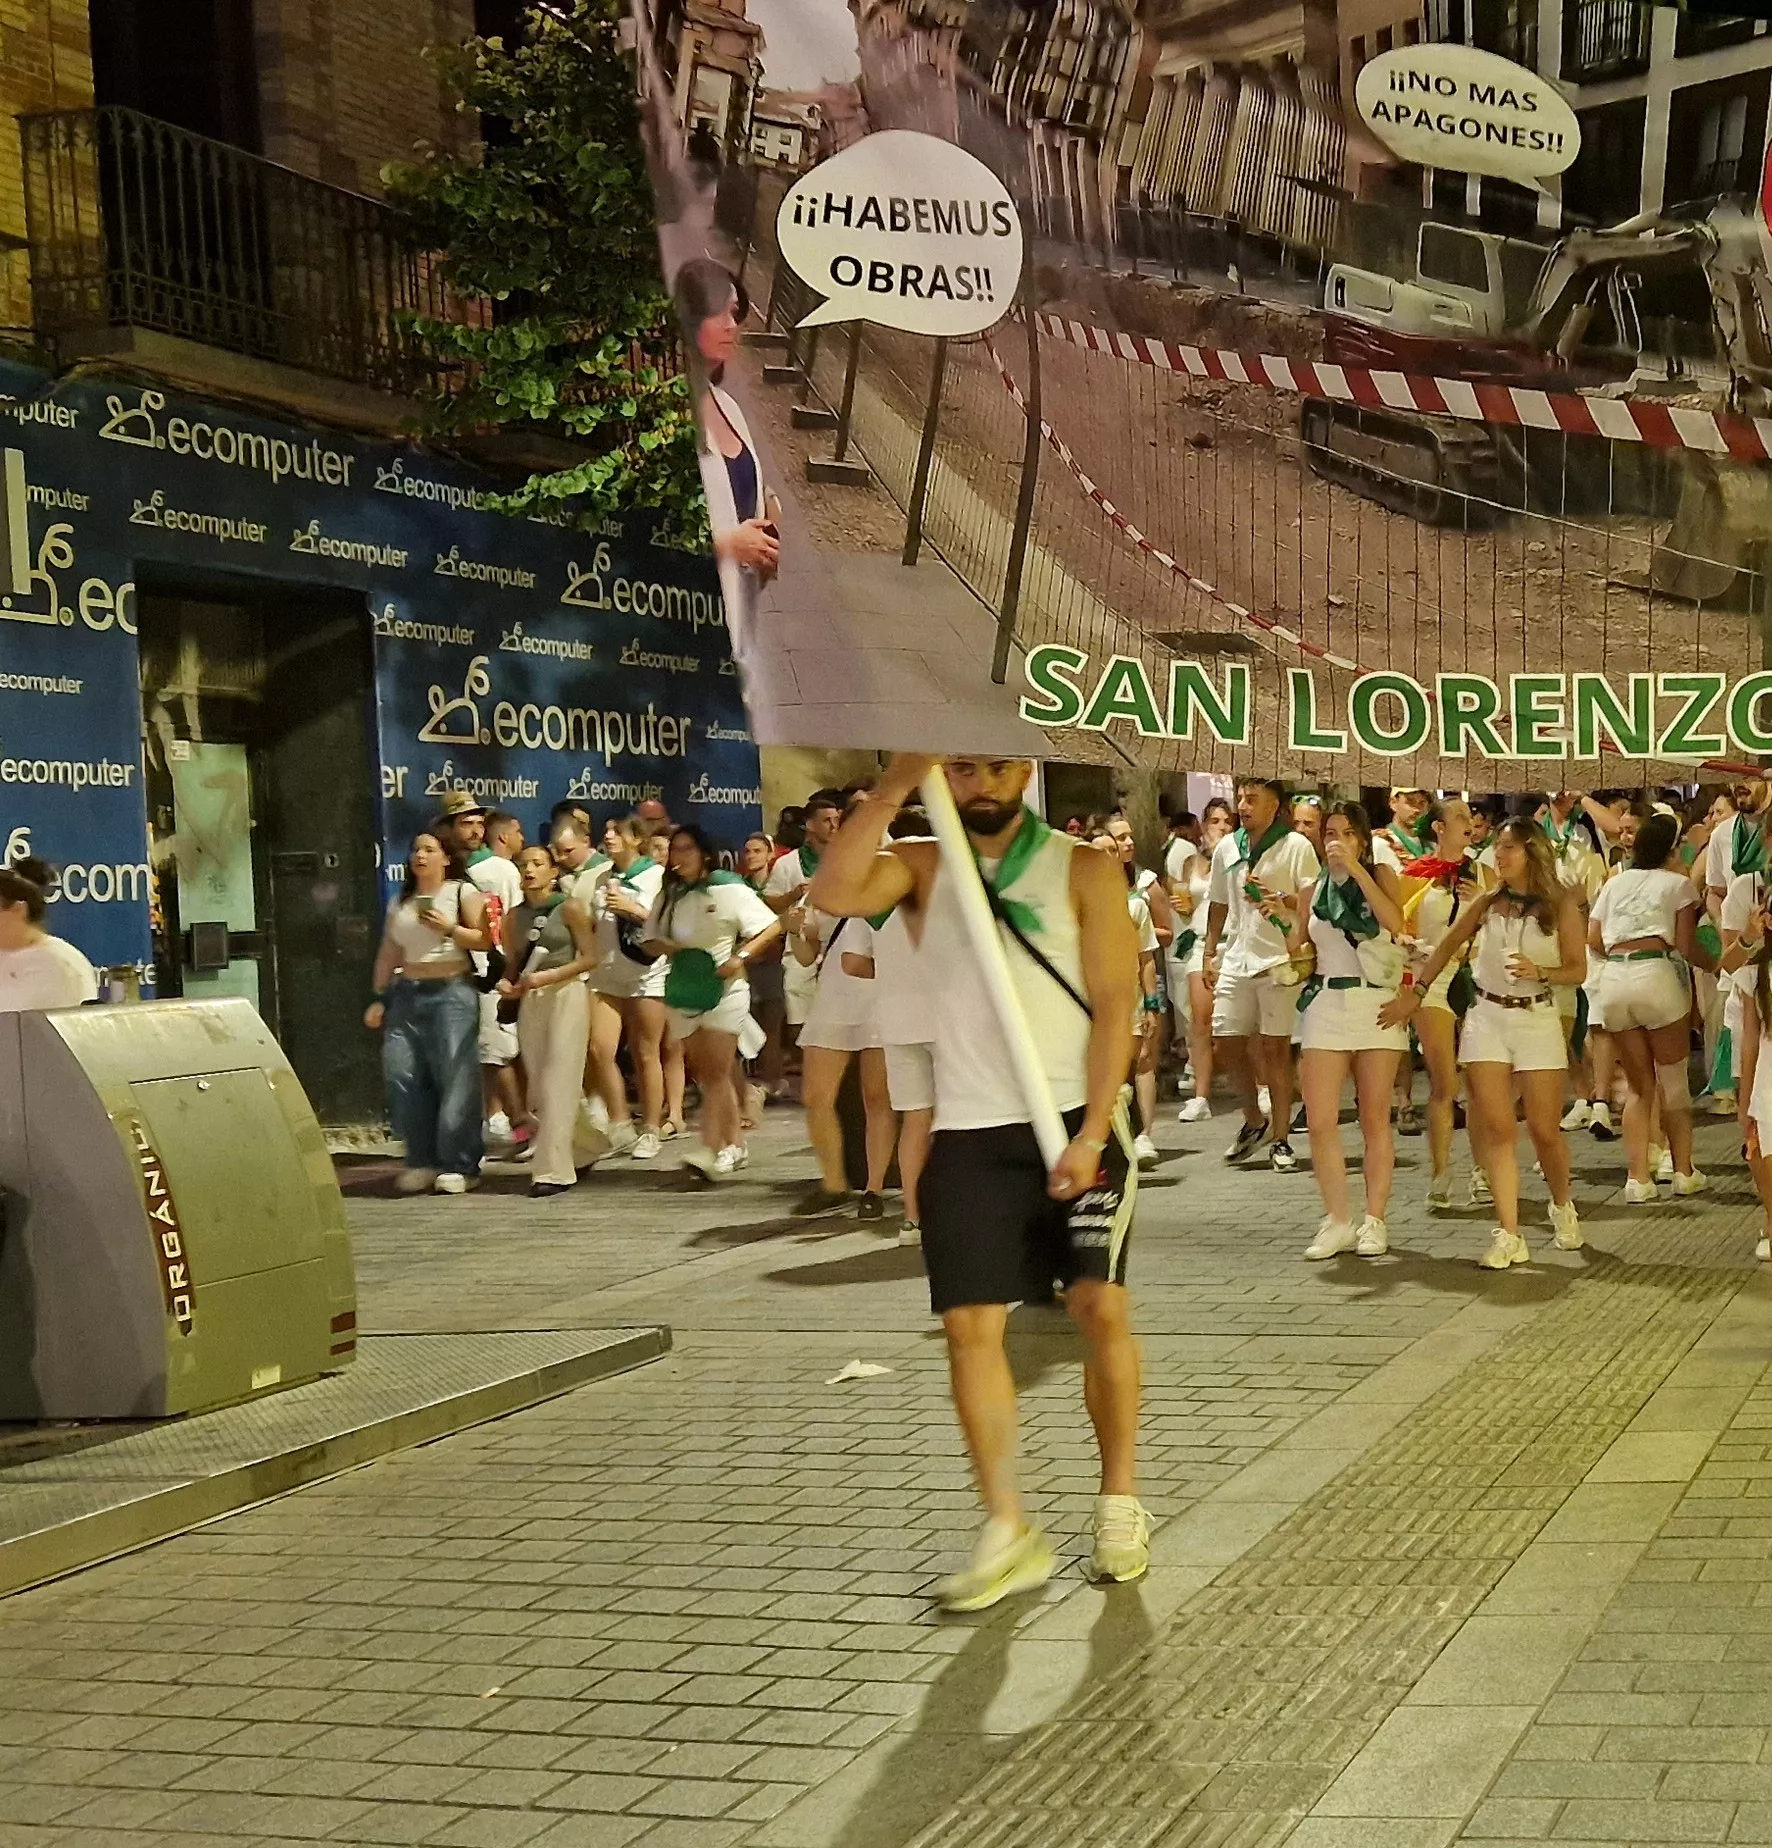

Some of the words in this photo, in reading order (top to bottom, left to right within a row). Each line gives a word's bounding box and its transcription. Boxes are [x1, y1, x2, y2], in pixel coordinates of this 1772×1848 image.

[1469, 83, 1538, 112] MAS
[1371, 100, 1564, 154] APAGONES!!
[793, 192, 1012, 237] ¡¡HABEMUS
[829, 255, 995, 302] OBRAS!!
[1019, 643, 1251, 746] SAN
